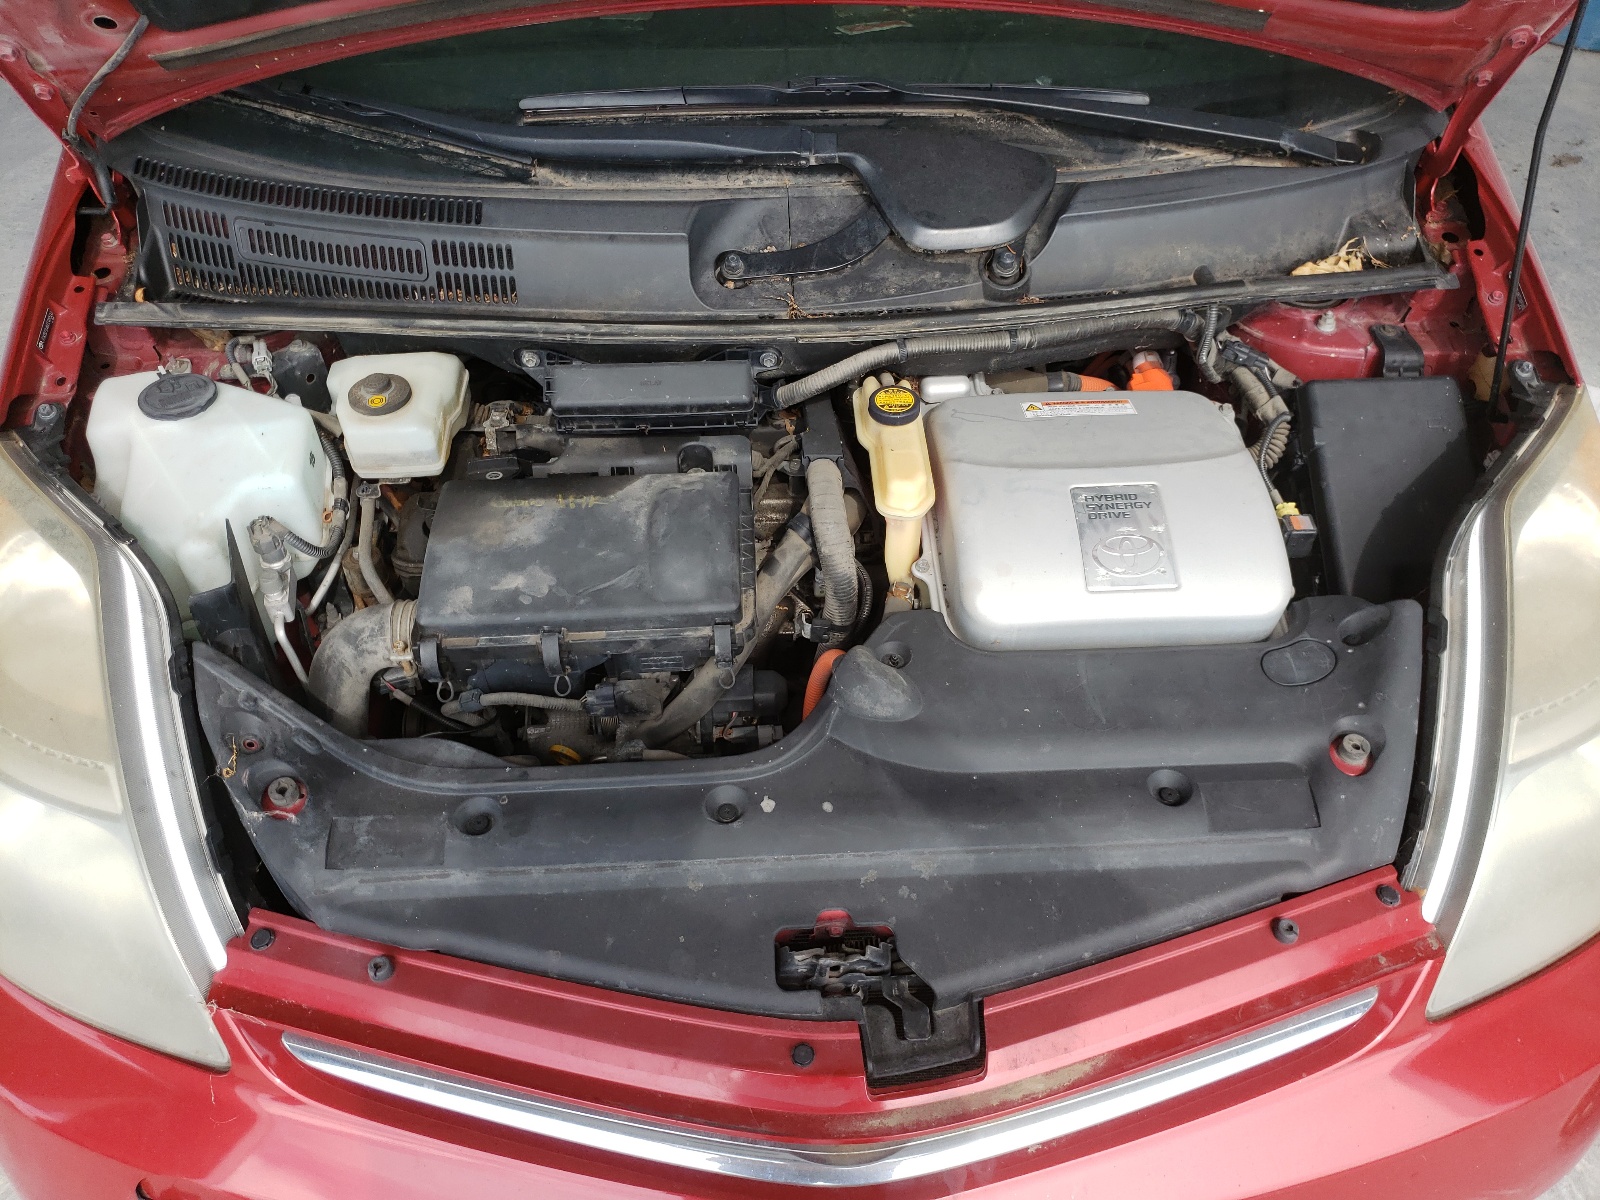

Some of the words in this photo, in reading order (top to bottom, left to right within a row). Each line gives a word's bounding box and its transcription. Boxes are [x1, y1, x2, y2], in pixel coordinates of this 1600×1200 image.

[1084, 493, 1138, 502] HYBRID
[1085, 502, 1152, 511] SYNERGY
[1088, 511, 1131, 520] DRIVE
